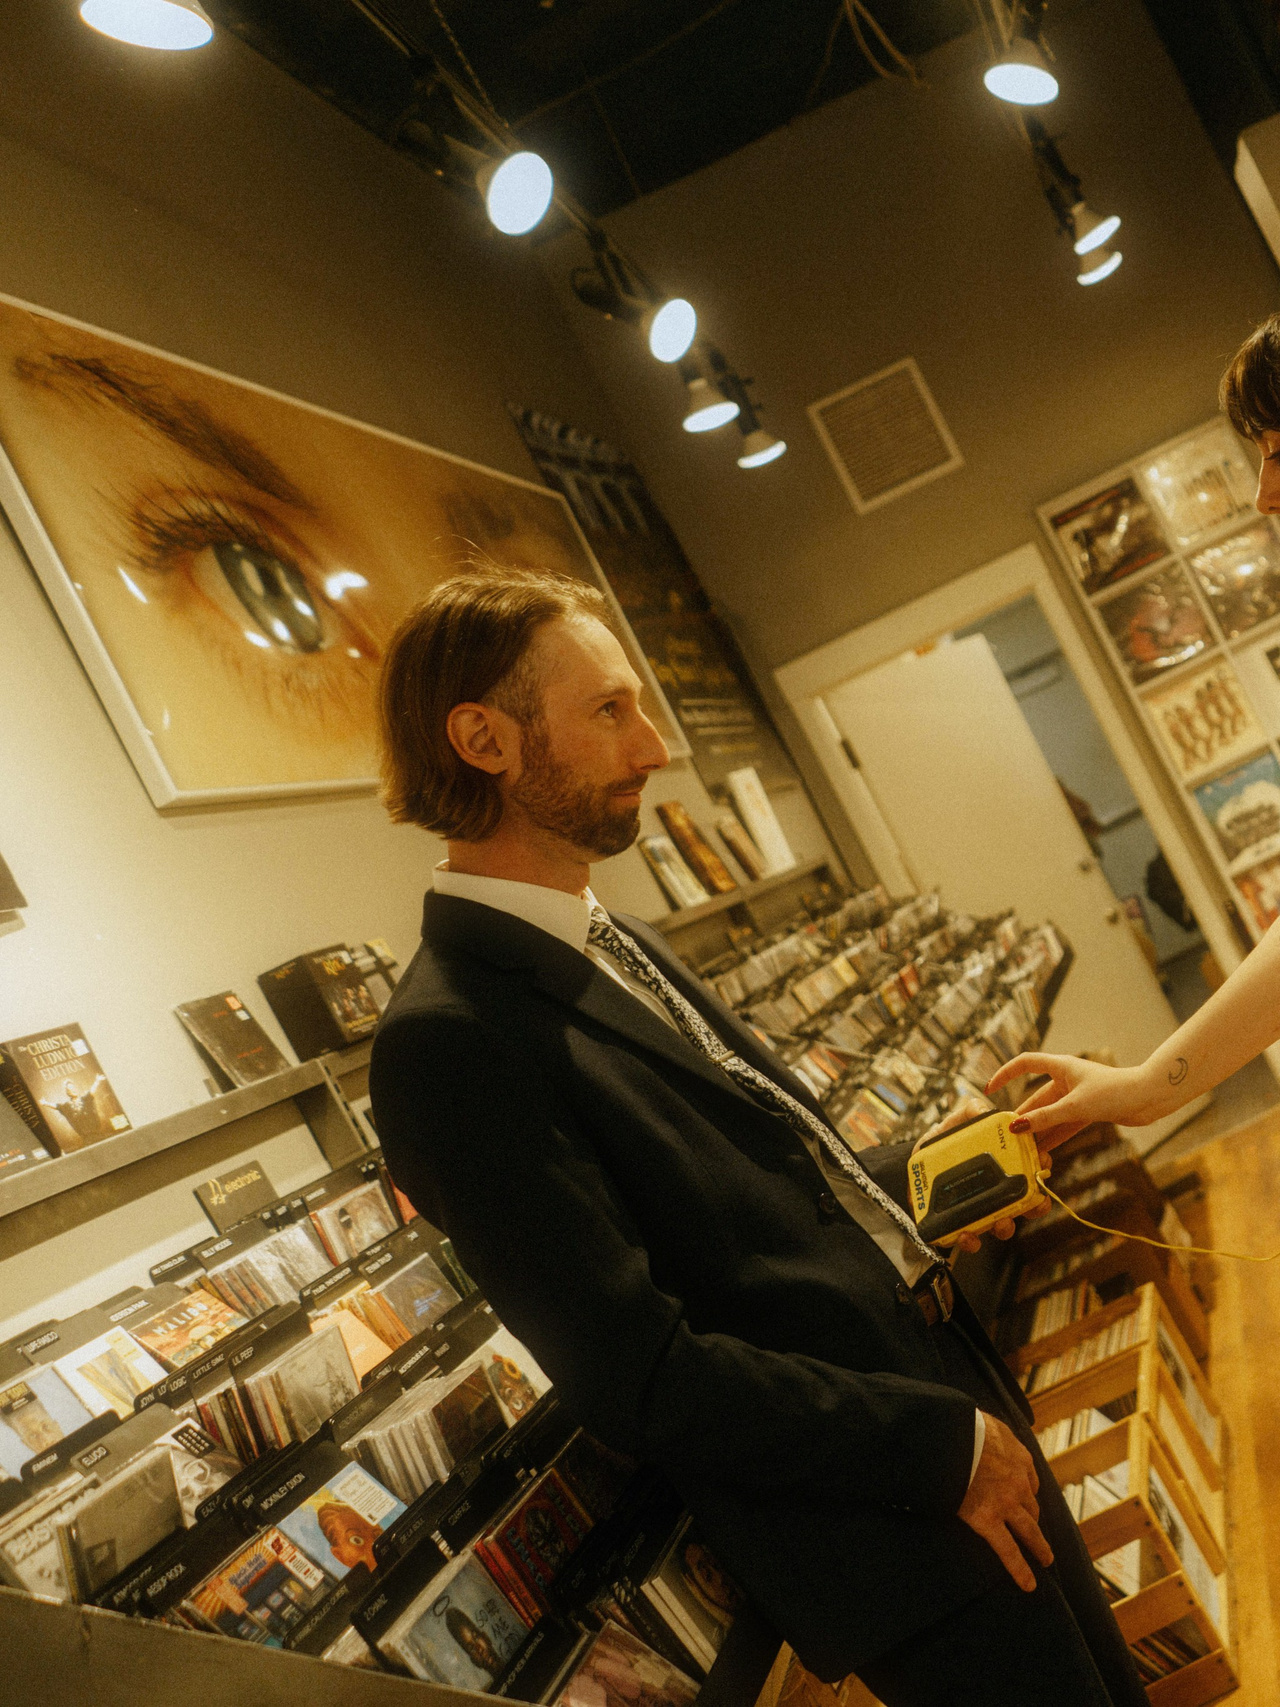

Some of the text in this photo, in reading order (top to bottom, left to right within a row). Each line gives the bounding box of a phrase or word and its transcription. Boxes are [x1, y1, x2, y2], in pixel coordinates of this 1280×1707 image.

[27, 1034, 73, 1056] CHRISTA
[40, 1058, 85, 1081] EDITION
[911, 1162, 926, 1211] SPORTS
[230, 1346, 256, 1366] LIL PEEP
[191, 1362, 212, 1378] LITTLE
[168, 1375, 188, 1391] LOGIC
[259, 1471, 306, 1511] MCKINLEY DIXON
